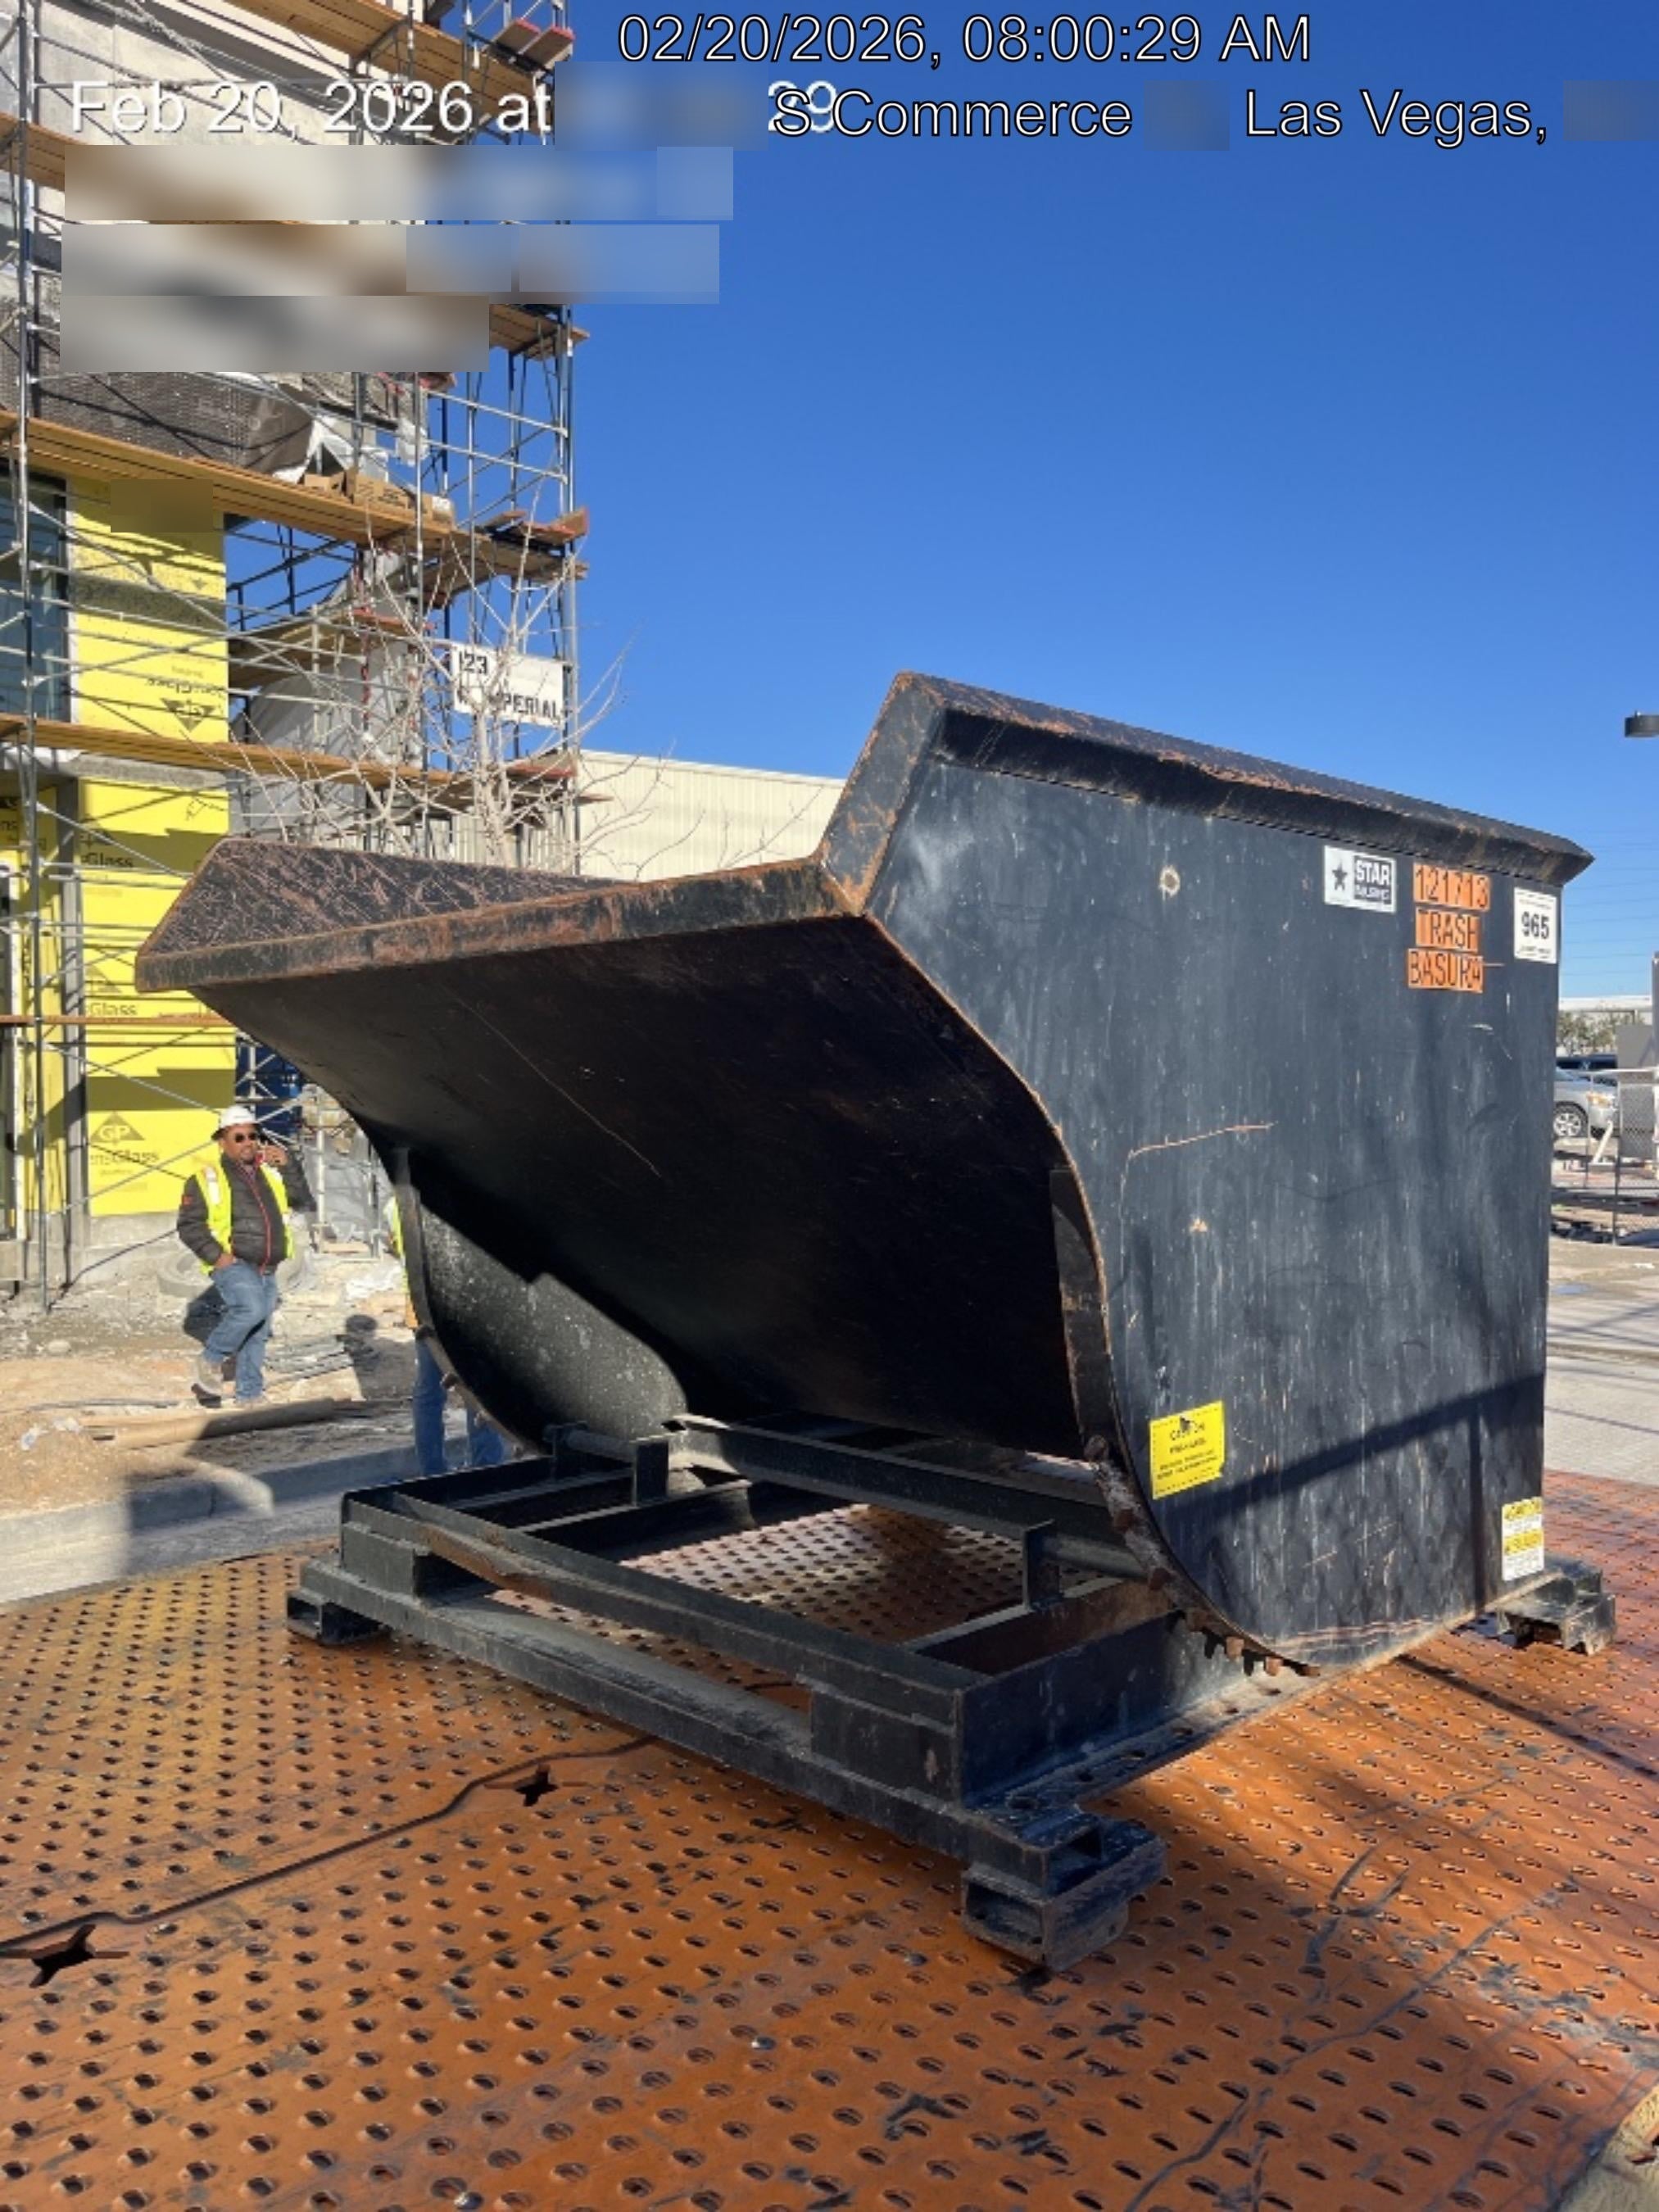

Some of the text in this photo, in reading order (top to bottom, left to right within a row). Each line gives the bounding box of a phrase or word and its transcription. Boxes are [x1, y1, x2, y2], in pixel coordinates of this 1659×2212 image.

[1356, 859, 1390, 886] STAR
[1417, 909, 1480, 949] TRASH
[1521, 911, 1550, 940] 965
